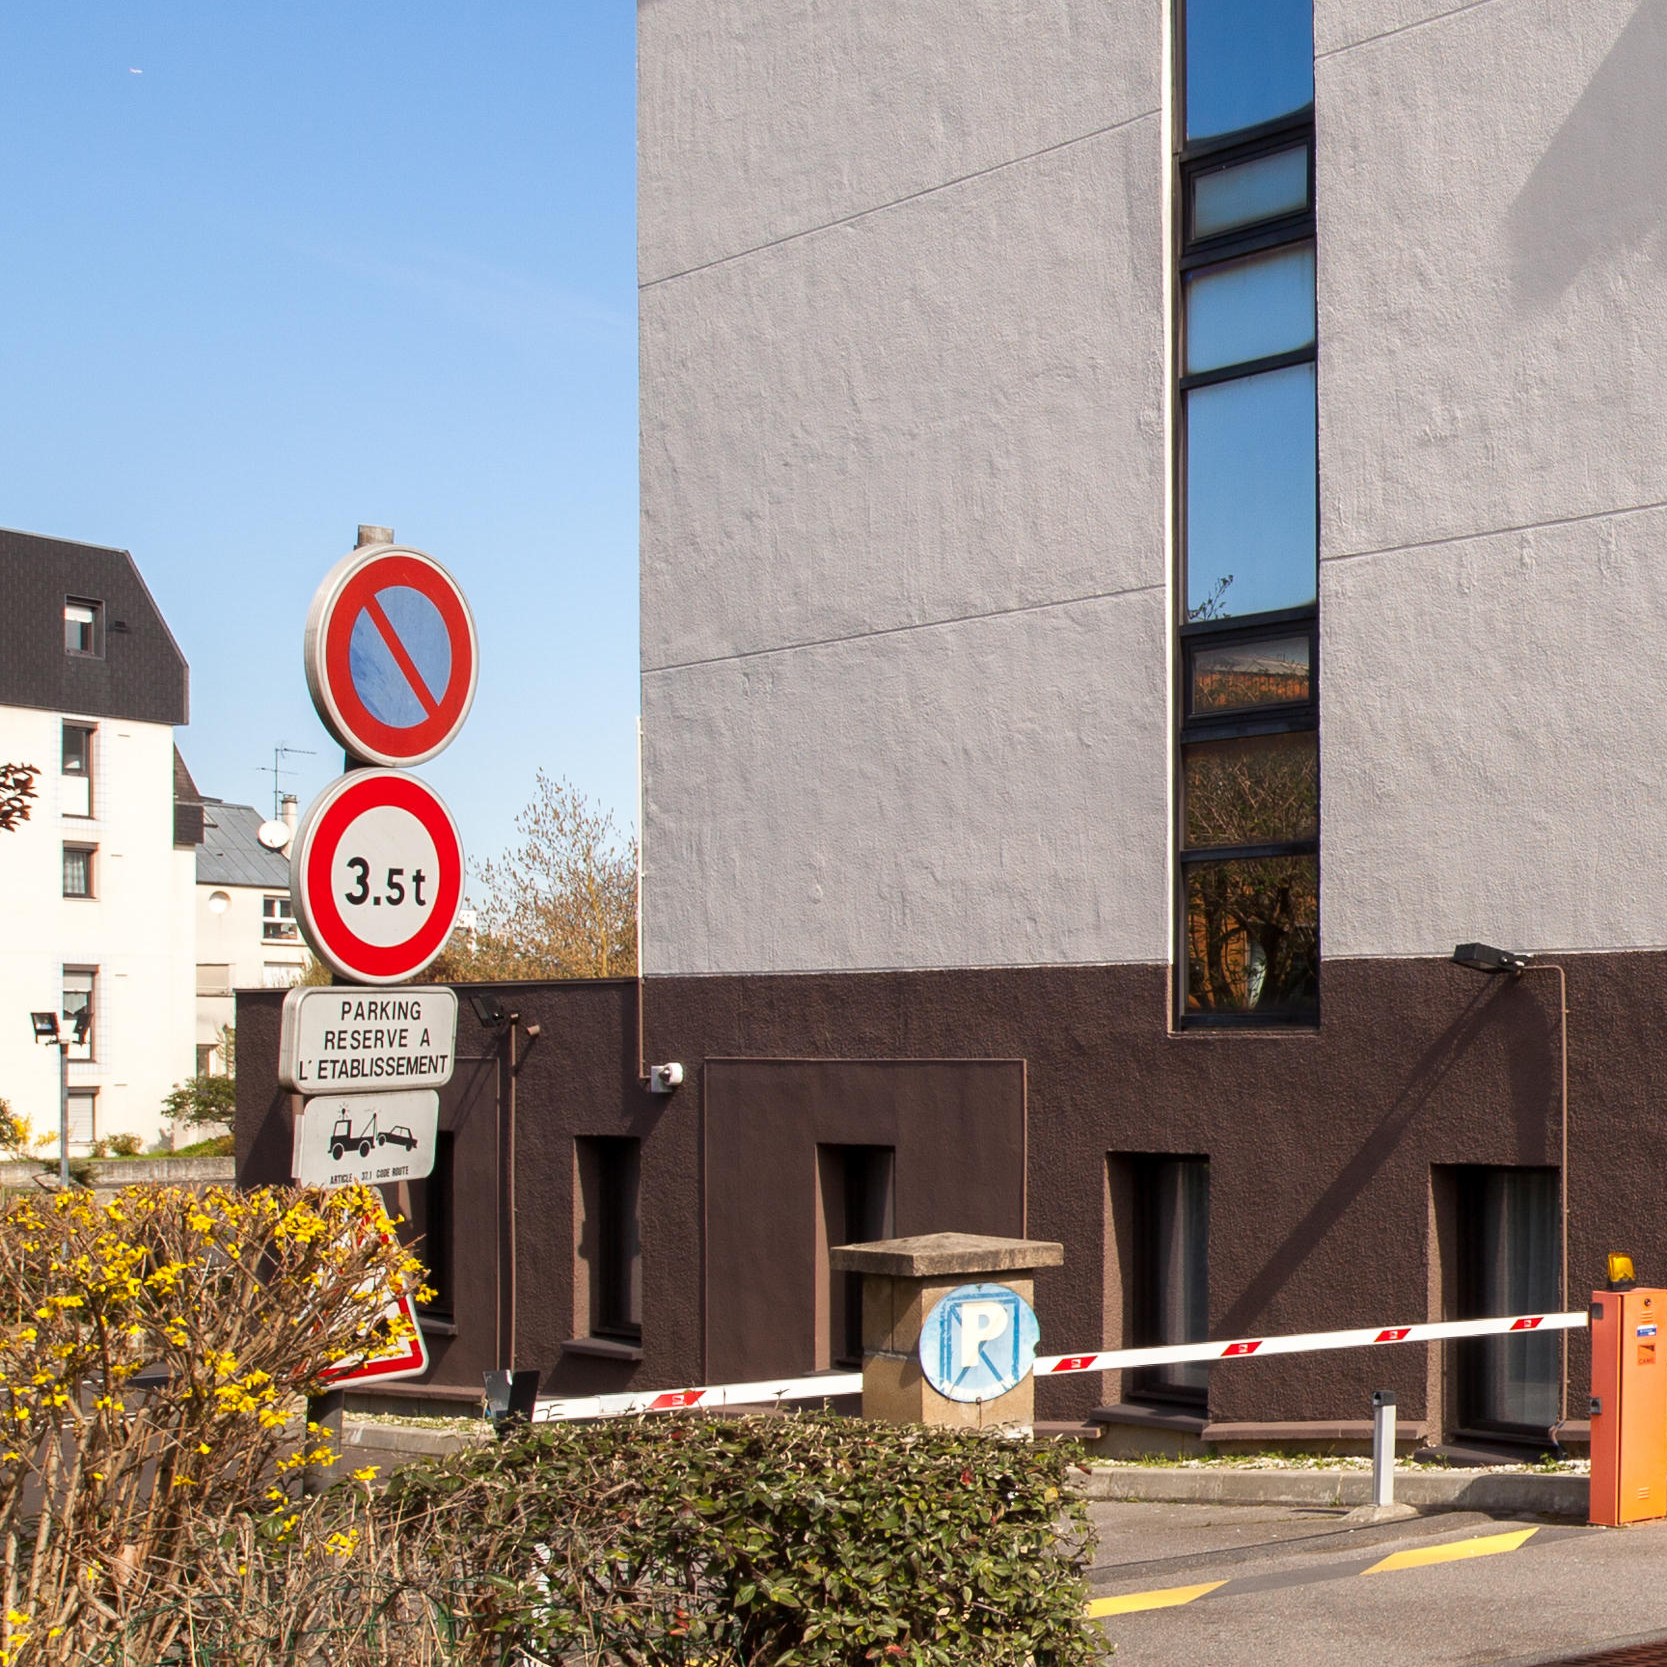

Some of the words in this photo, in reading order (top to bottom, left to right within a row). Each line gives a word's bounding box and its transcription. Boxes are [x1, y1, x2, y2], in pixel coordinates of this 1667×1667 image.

[341, 1000, 422, 1021] PARKING
[324, 1028, 409, 1051] RESERVE
[419, 1027, 431, 1048] A
[330, 1173, 353, 1185] ARTICLE
[376, 1168, 391, 1179] CODE
[391, 1165, 409, 1177] ROUTE
[961, 1302, 1008, 1368] P
